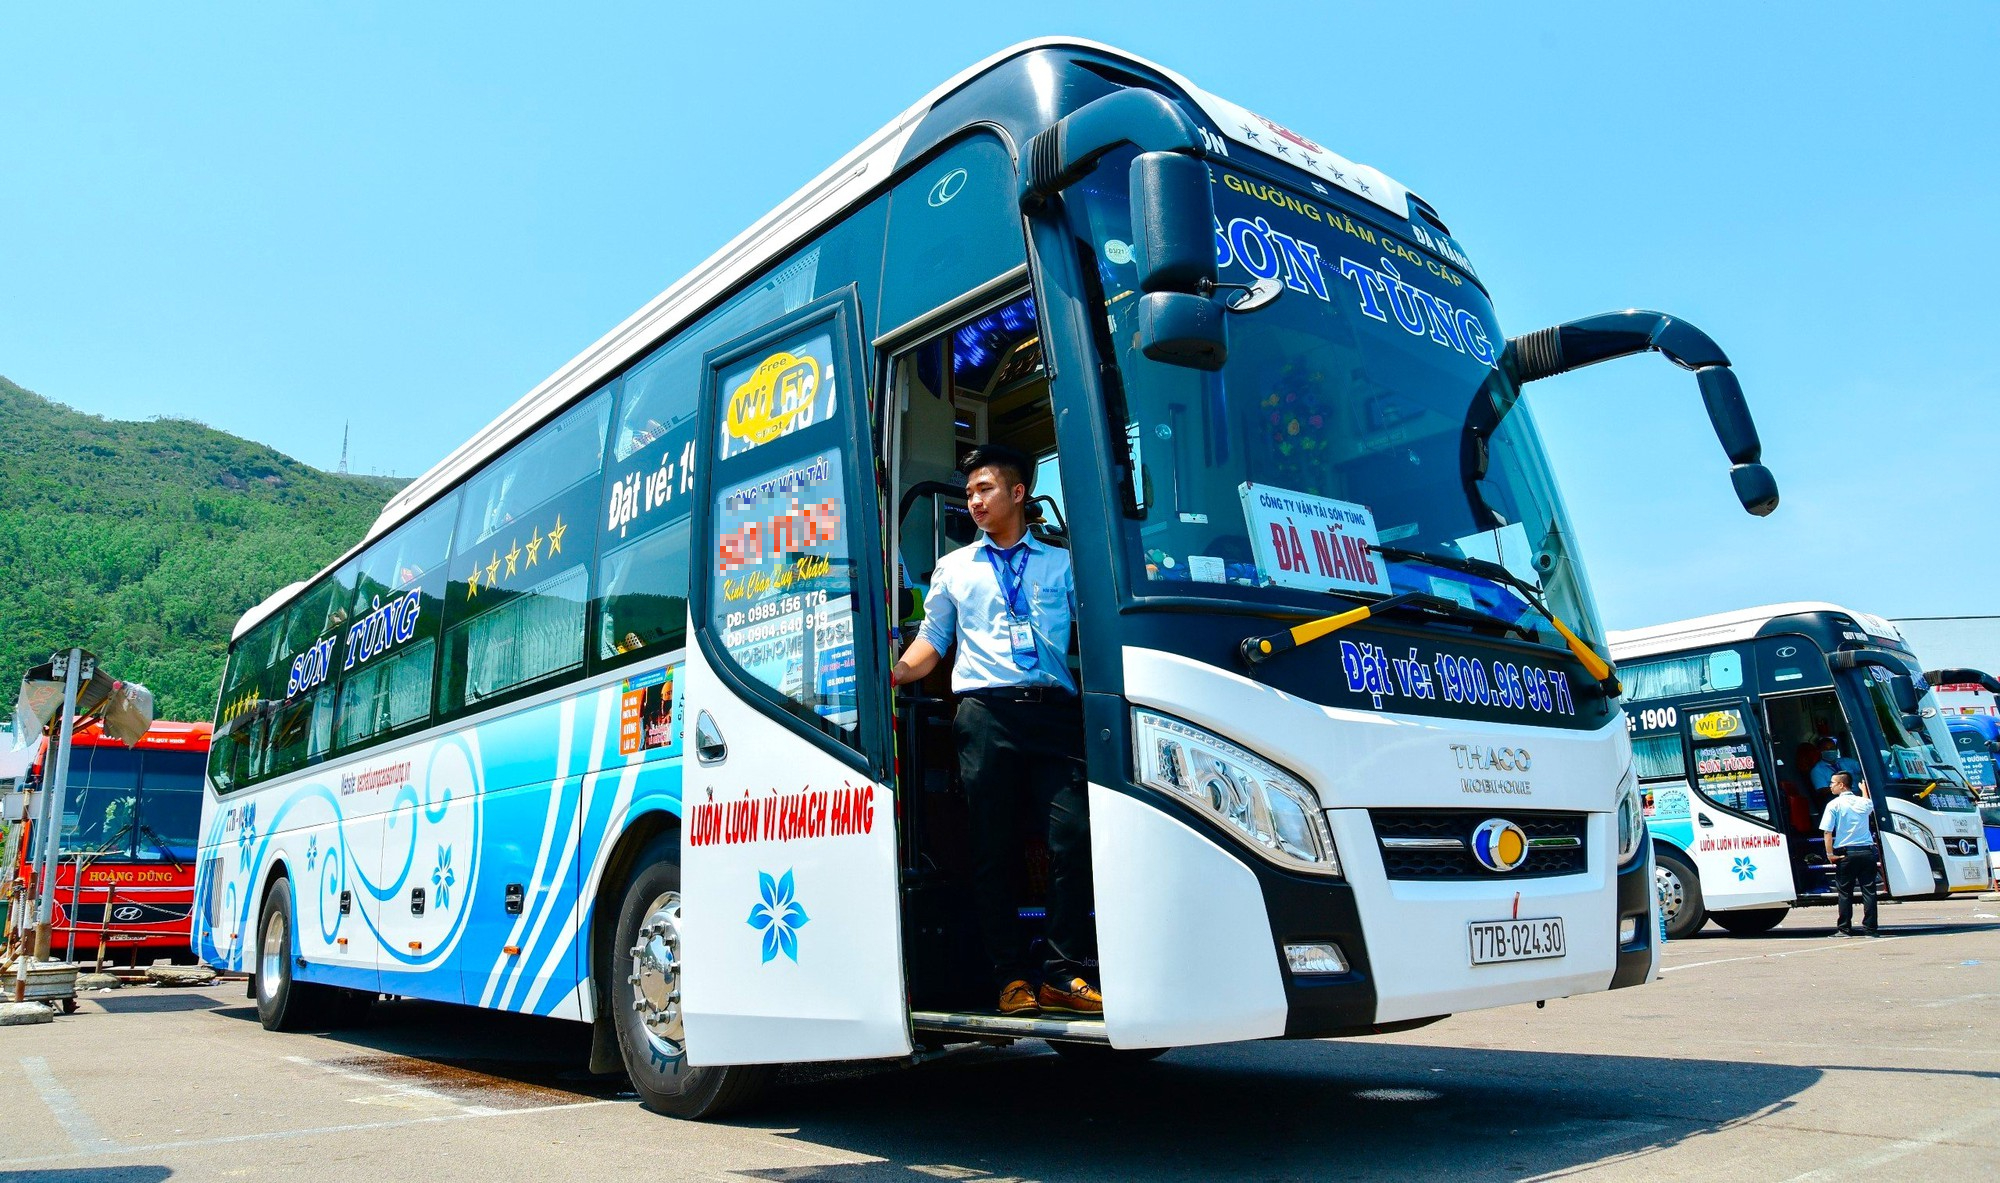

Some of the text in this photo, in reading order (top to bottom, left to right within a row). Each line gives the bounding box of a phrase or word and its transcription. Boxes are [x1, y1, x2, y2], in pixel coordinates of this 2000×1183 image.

[1223, 174, 1321, 221] GIƯỜNG
[1382, 238, 1423, 267] CAO
[1412, 225, 1437, 251] ĐÀ
[1340, 256, 1499, 371] TÙNG
[759, 357, 788, 376] Free
[608, 471, 641, 538] Đặt
[645, 451, 675, 512] vé:
[1259, 493, 1284, 510] CÔNG
[1283, 499, 1295, 513] TY
[1328, 507, 1345, 521] SƠN
[1344, 509, 1366, 525] TÙNG
[1270, 517, 1378, 586] ĐÀ NẴNG
[748, 596, 801, 622] 0989.156
[805, 589, 827, 608] 176
[806, 611, 828, 630] 919
[287, 587, 422, 699] SƠN TÙNG
[1339, 640, 1575, 716] Đặt vé: 1900.96 96 71
[1640, 707, 1677, 731] 1900
[1450, 743, 1532, 772] THACO
[1699, 754, 1755, 774] SƠN TÙNG
[1460, 778, 1532, 795] MOBIHOME
[725, 789, 760, 845] LUÔN
[764, 787, 778, 841] VÌ
[778, 785, 828, 843] KHÁCH
[831, 780, 874, 836] HÀNG
[1717, 835, 1732, 850] LUÔN
[1733, 835, 1740, 849] VÌ
[1741, 834, 1762, 849] KHÁCH
[1763, 833, 1780, 848] HÀNG
[89, 869, 173, 882] HOÀNG DŨNG
